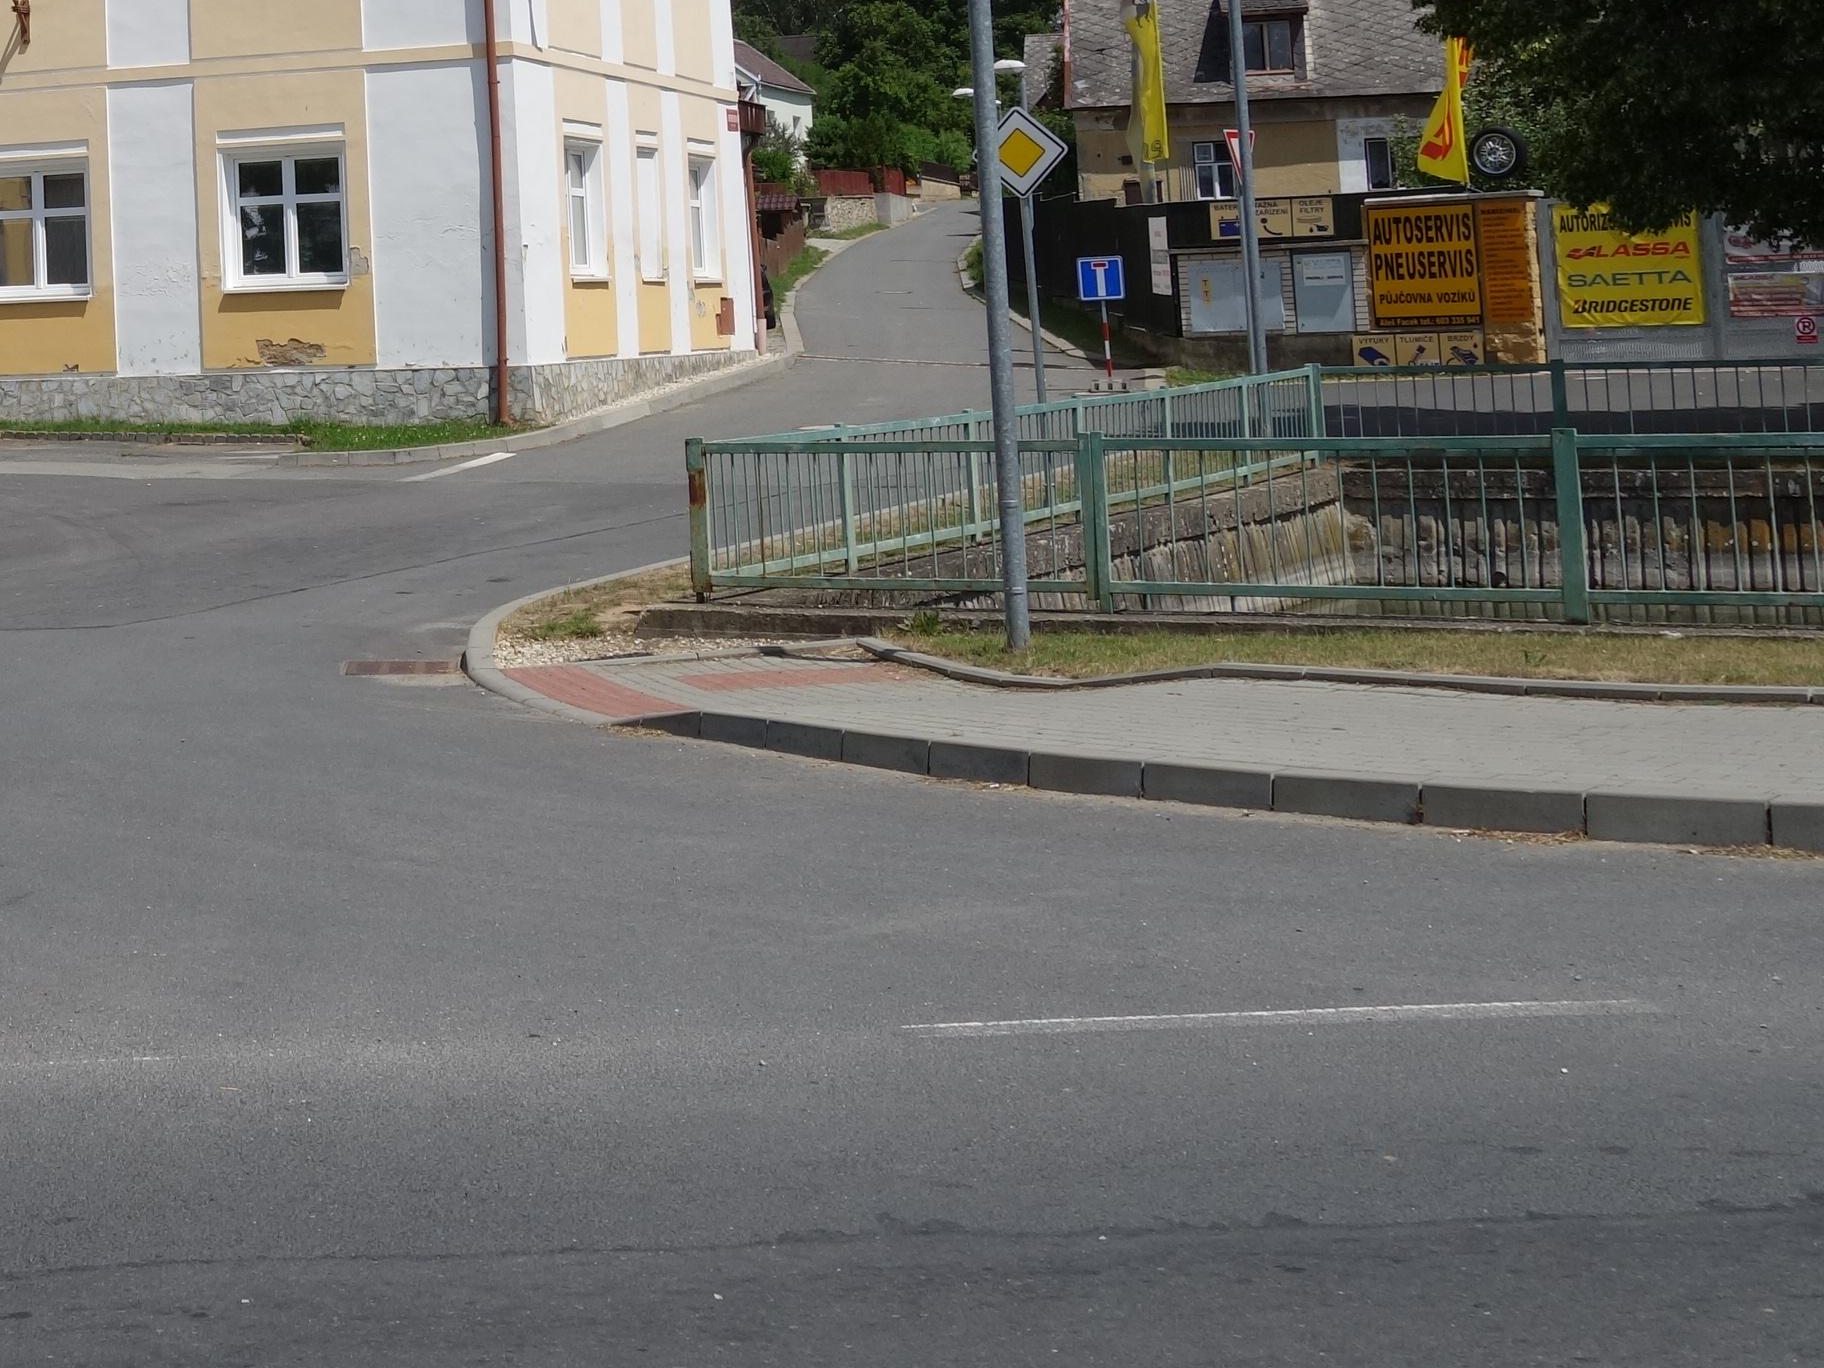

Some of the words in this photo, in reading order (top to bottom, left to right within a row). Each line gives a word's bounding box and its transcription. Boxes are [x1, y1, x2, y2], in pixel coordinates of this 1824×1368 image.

[1299, 199, 1324, 207] OLEJE
[1299, 206, 1325, 214] FILTRY
[1373, 212, 1472, 246] AUTOSERVIS
[1594, 241, 1691, 258] LASSA
[1374, 248, 1475, 281] PNEUSERVIS
[1567, 269, 1693, 288] SAETTA
[1379, 290, 1433, 305] PŮJČOVNA
[1435, 288, 1476, 304] VOZÍKŮ
[1572, 297, 1694, 314] BRIDGESTONE
